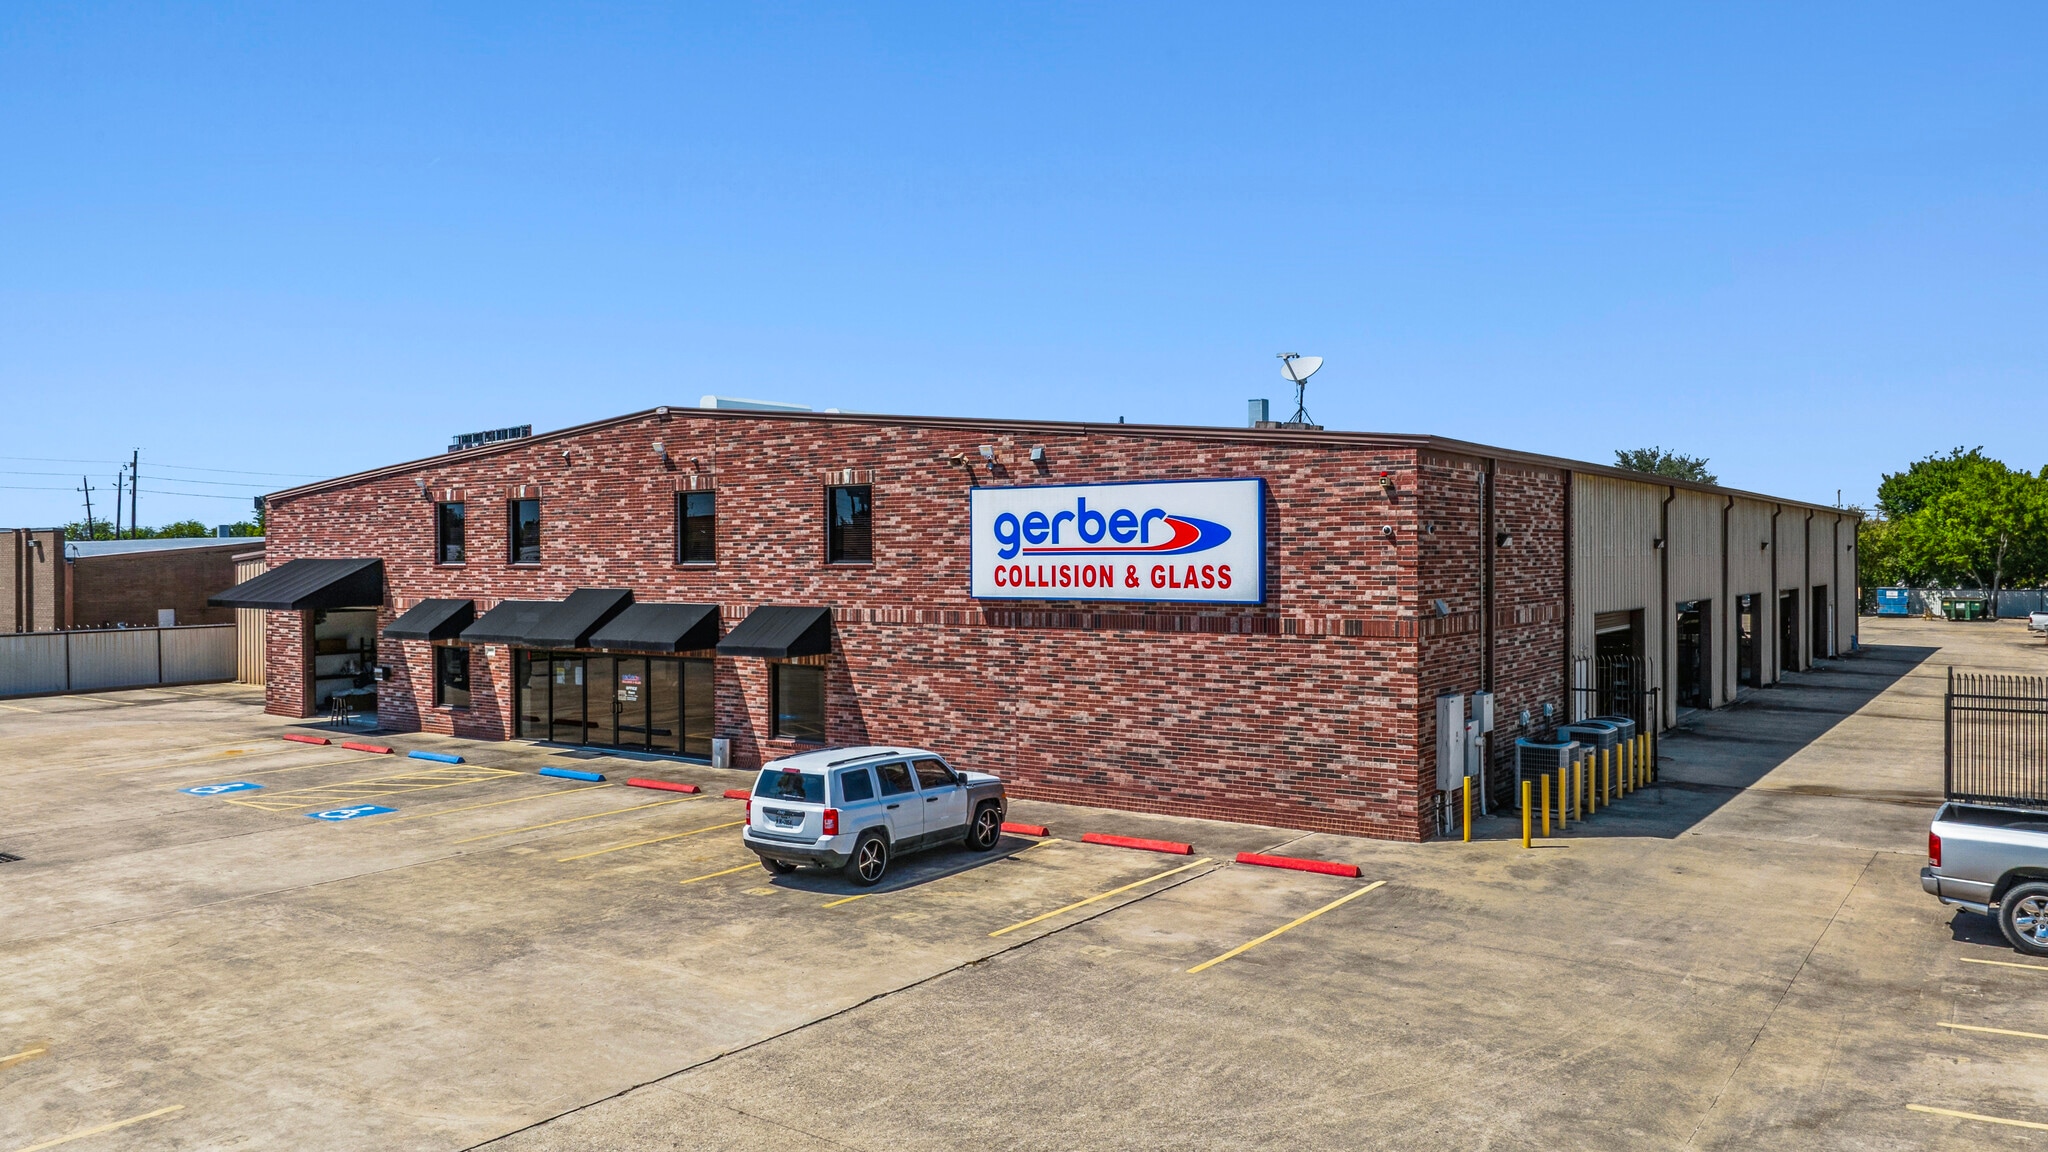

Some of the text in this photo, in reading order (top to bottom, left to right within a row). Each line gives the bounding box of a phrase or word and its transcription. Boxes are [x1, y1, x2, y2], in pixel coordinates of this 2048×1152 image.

[994, 497, 1166, 560] gerber
[994, 564, 1232, 589] COLLISION & GLASS
